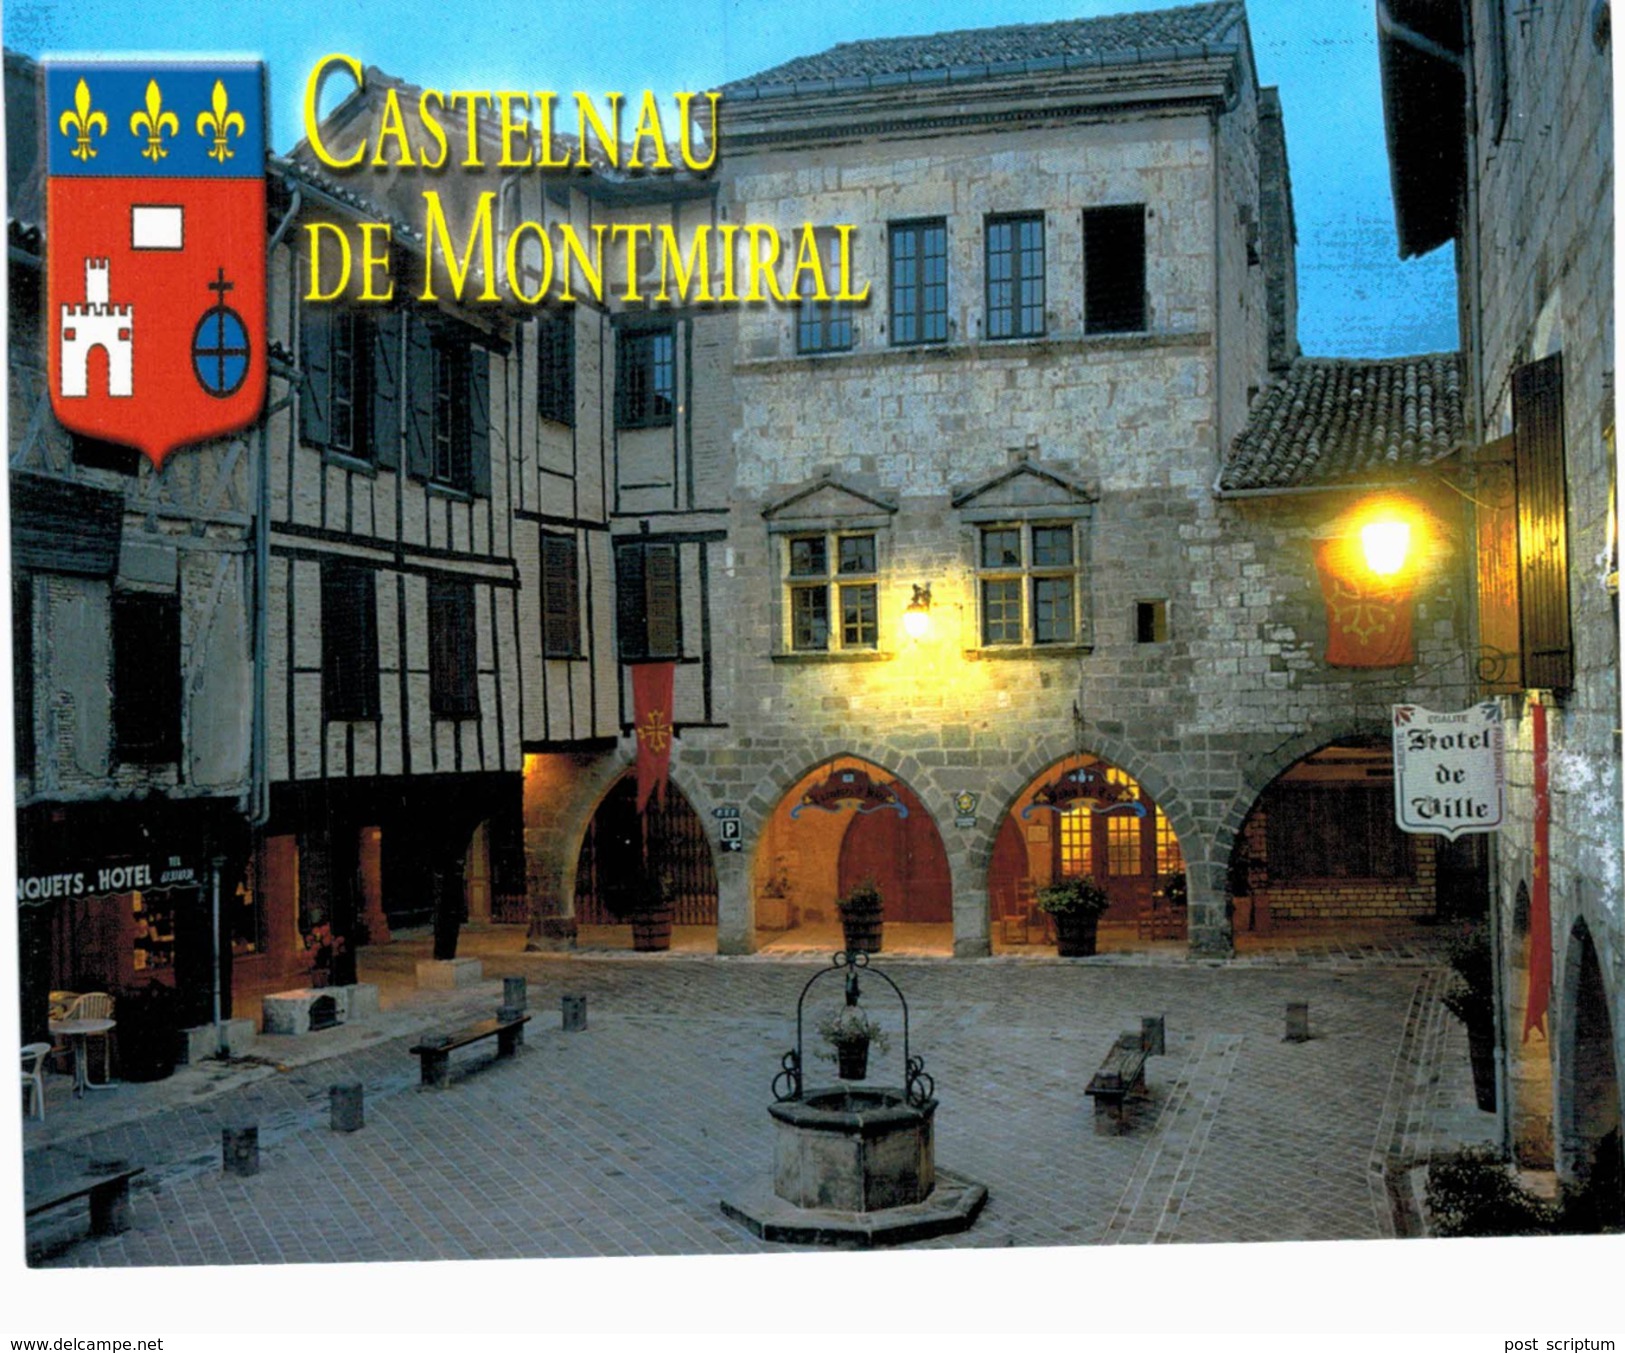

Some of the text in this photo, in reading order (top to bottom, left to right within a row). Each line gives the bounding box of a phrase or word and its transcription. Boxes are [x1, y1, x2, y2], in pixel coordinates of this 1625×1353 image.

[1407, 728, 1490, 751] Hotel
[1435, 763, 1466, 784] de
[1411, 796, 1489, 819] Ville
[725, 822, 736, 837] P
[98, 865, 152, 891] HOTEL
